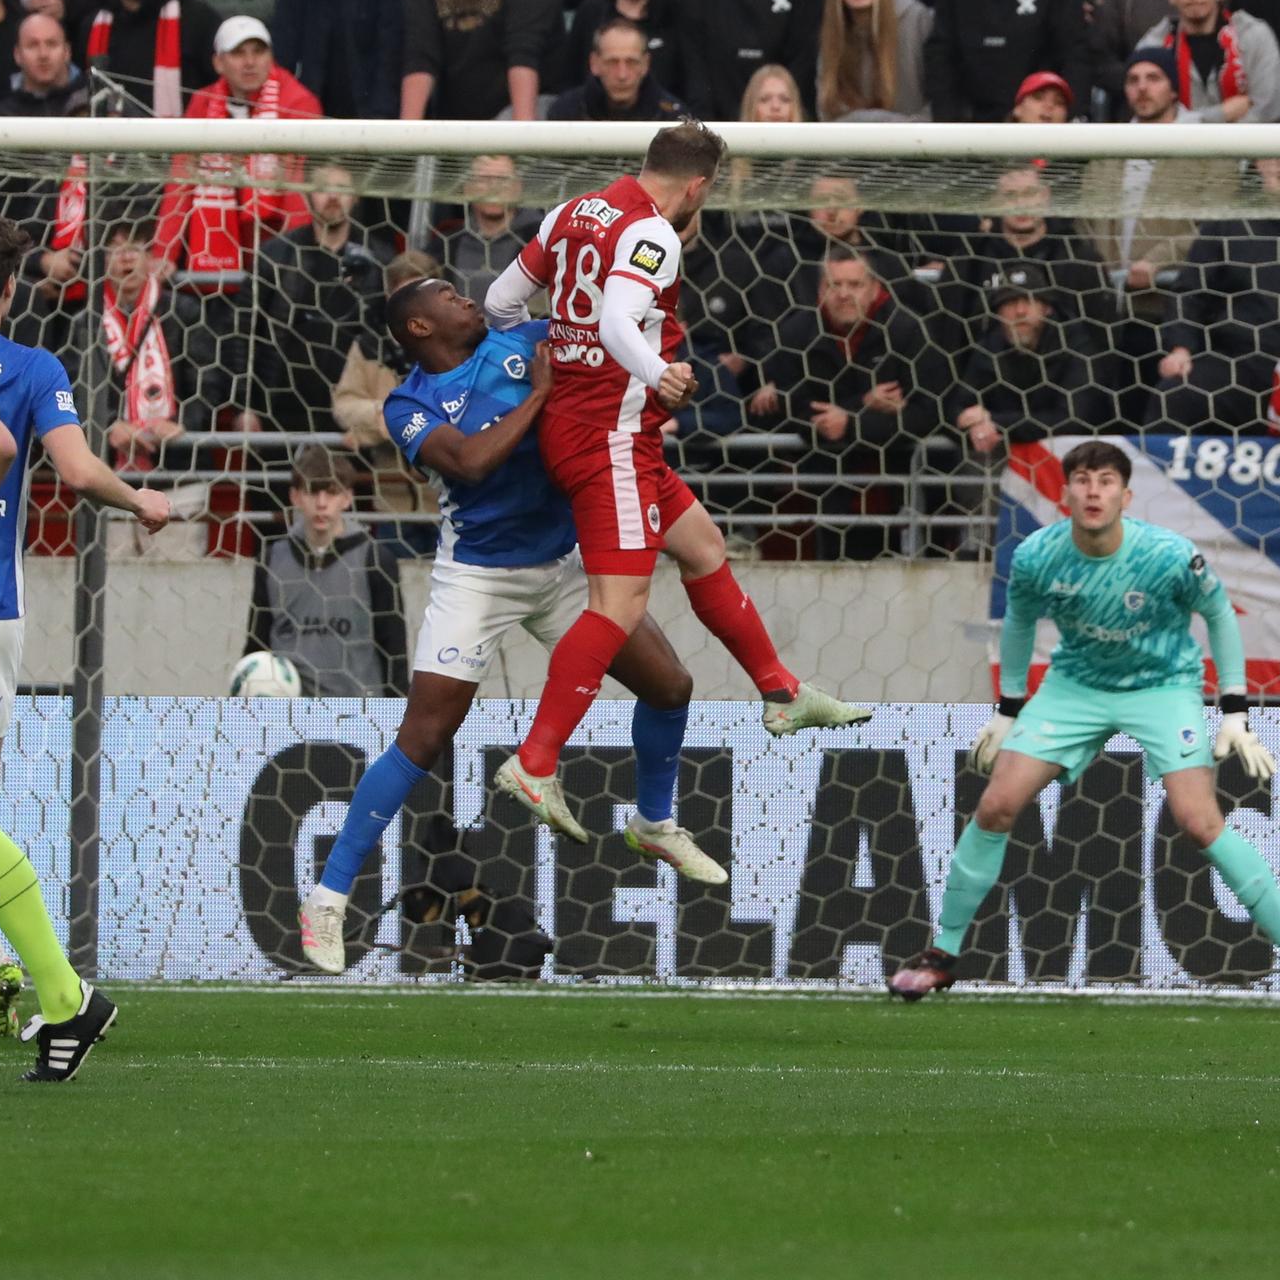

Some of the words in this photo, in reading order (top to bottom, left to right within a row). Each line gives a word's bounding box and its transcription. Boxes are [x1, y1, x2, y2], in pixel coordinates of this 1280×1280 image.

[638, 243, 663, 262] bet
[632, 253, 659, 270] FIRST
[551, 238, 604, 325] 18
[55, 391, 74, 404] STA
[475, 644, 483, 656] 3
